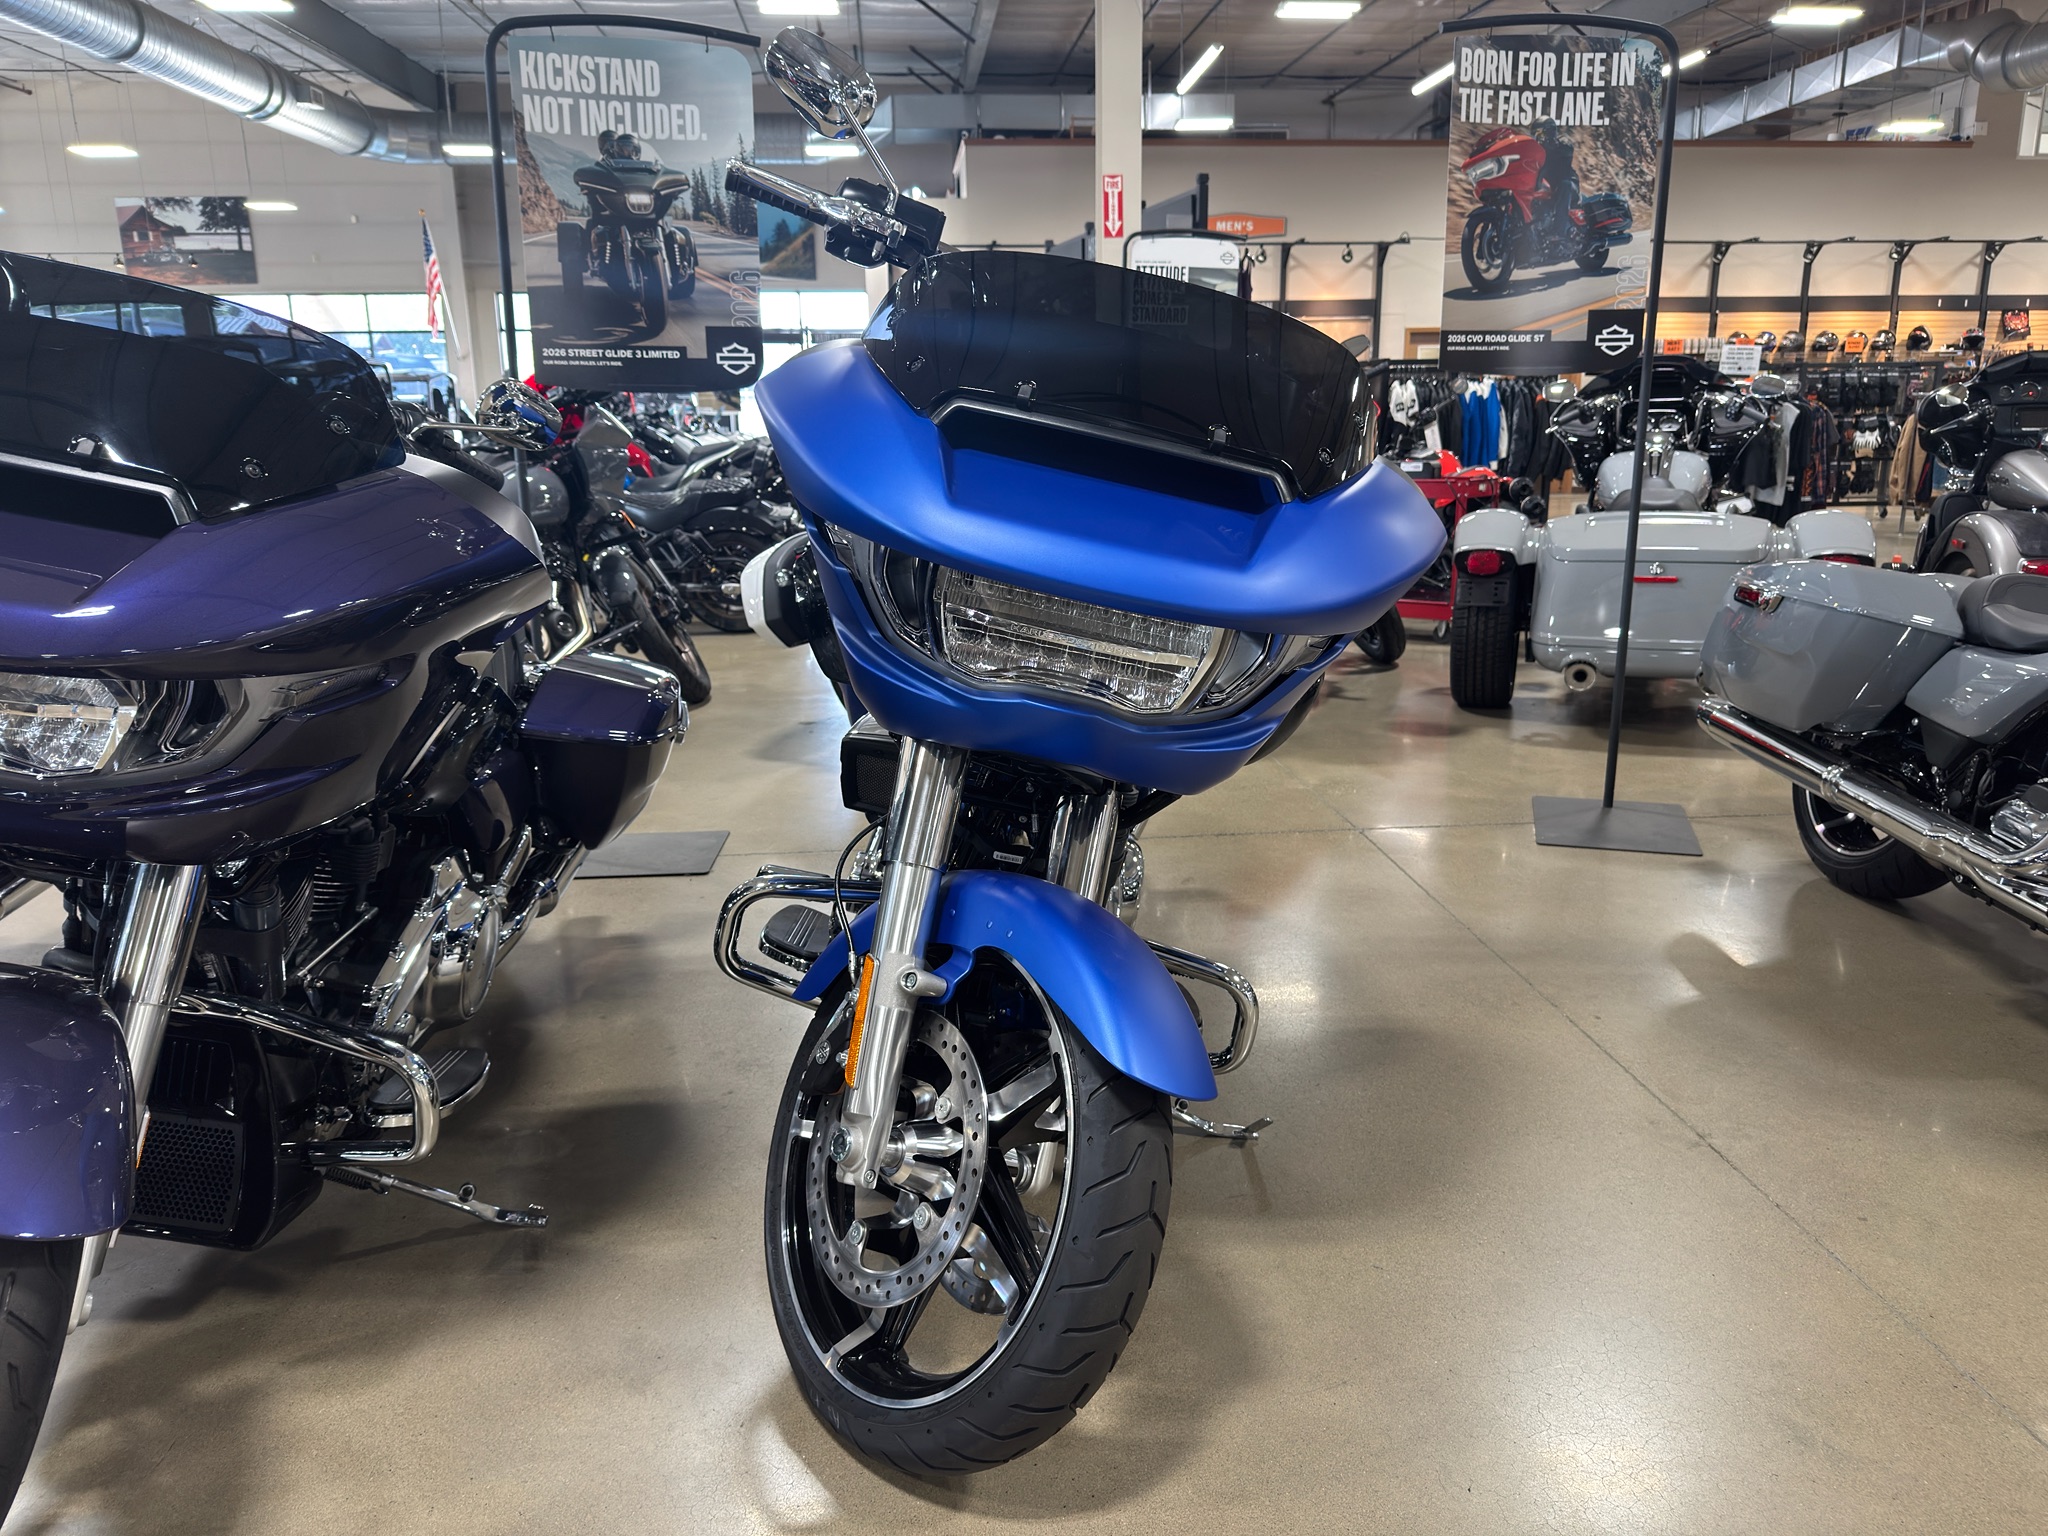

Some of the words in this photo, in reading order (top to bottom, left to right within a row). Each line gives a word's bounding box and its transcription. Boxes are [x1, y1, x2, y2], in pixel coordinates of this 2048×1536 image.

[519, 49, 661, 97] KICKSTAND
[1459, 47, 1513, 86] BORN
[1517, 51, 1556, 87] FOR
[1561, 52, 1606, 87] LIFE
[1610, 51, 1636, 87] IN
[1458, 87, 1493, 124] THE
[1497, 90, 1546, 126] FAST
[1551, 92, 1610, 126] LANE.
[522, 94, 573, 135] NOT
[578, 98, 708, 141] INCLUDED.
[1106, 180, 1120, 189] FIRE
[1216, 221, 1254, 231] MEN'S
[1132, 306, 1187, 323] STANDARD
[1466, 334, 1483, 342] CVO
[1485, 334, 1507, 342] ROAD
[1508, 334, 1532, 342] GLIDE
[1533, 334, 1545, 342] ST
[542, 348, 566, 357] 2026
[567, 348, 604, 357] STREET
[605, 349, 633, 358] GLIDE
[635, 350, 642, 358] 3
[643, 350, 680, 359] LIMITED
